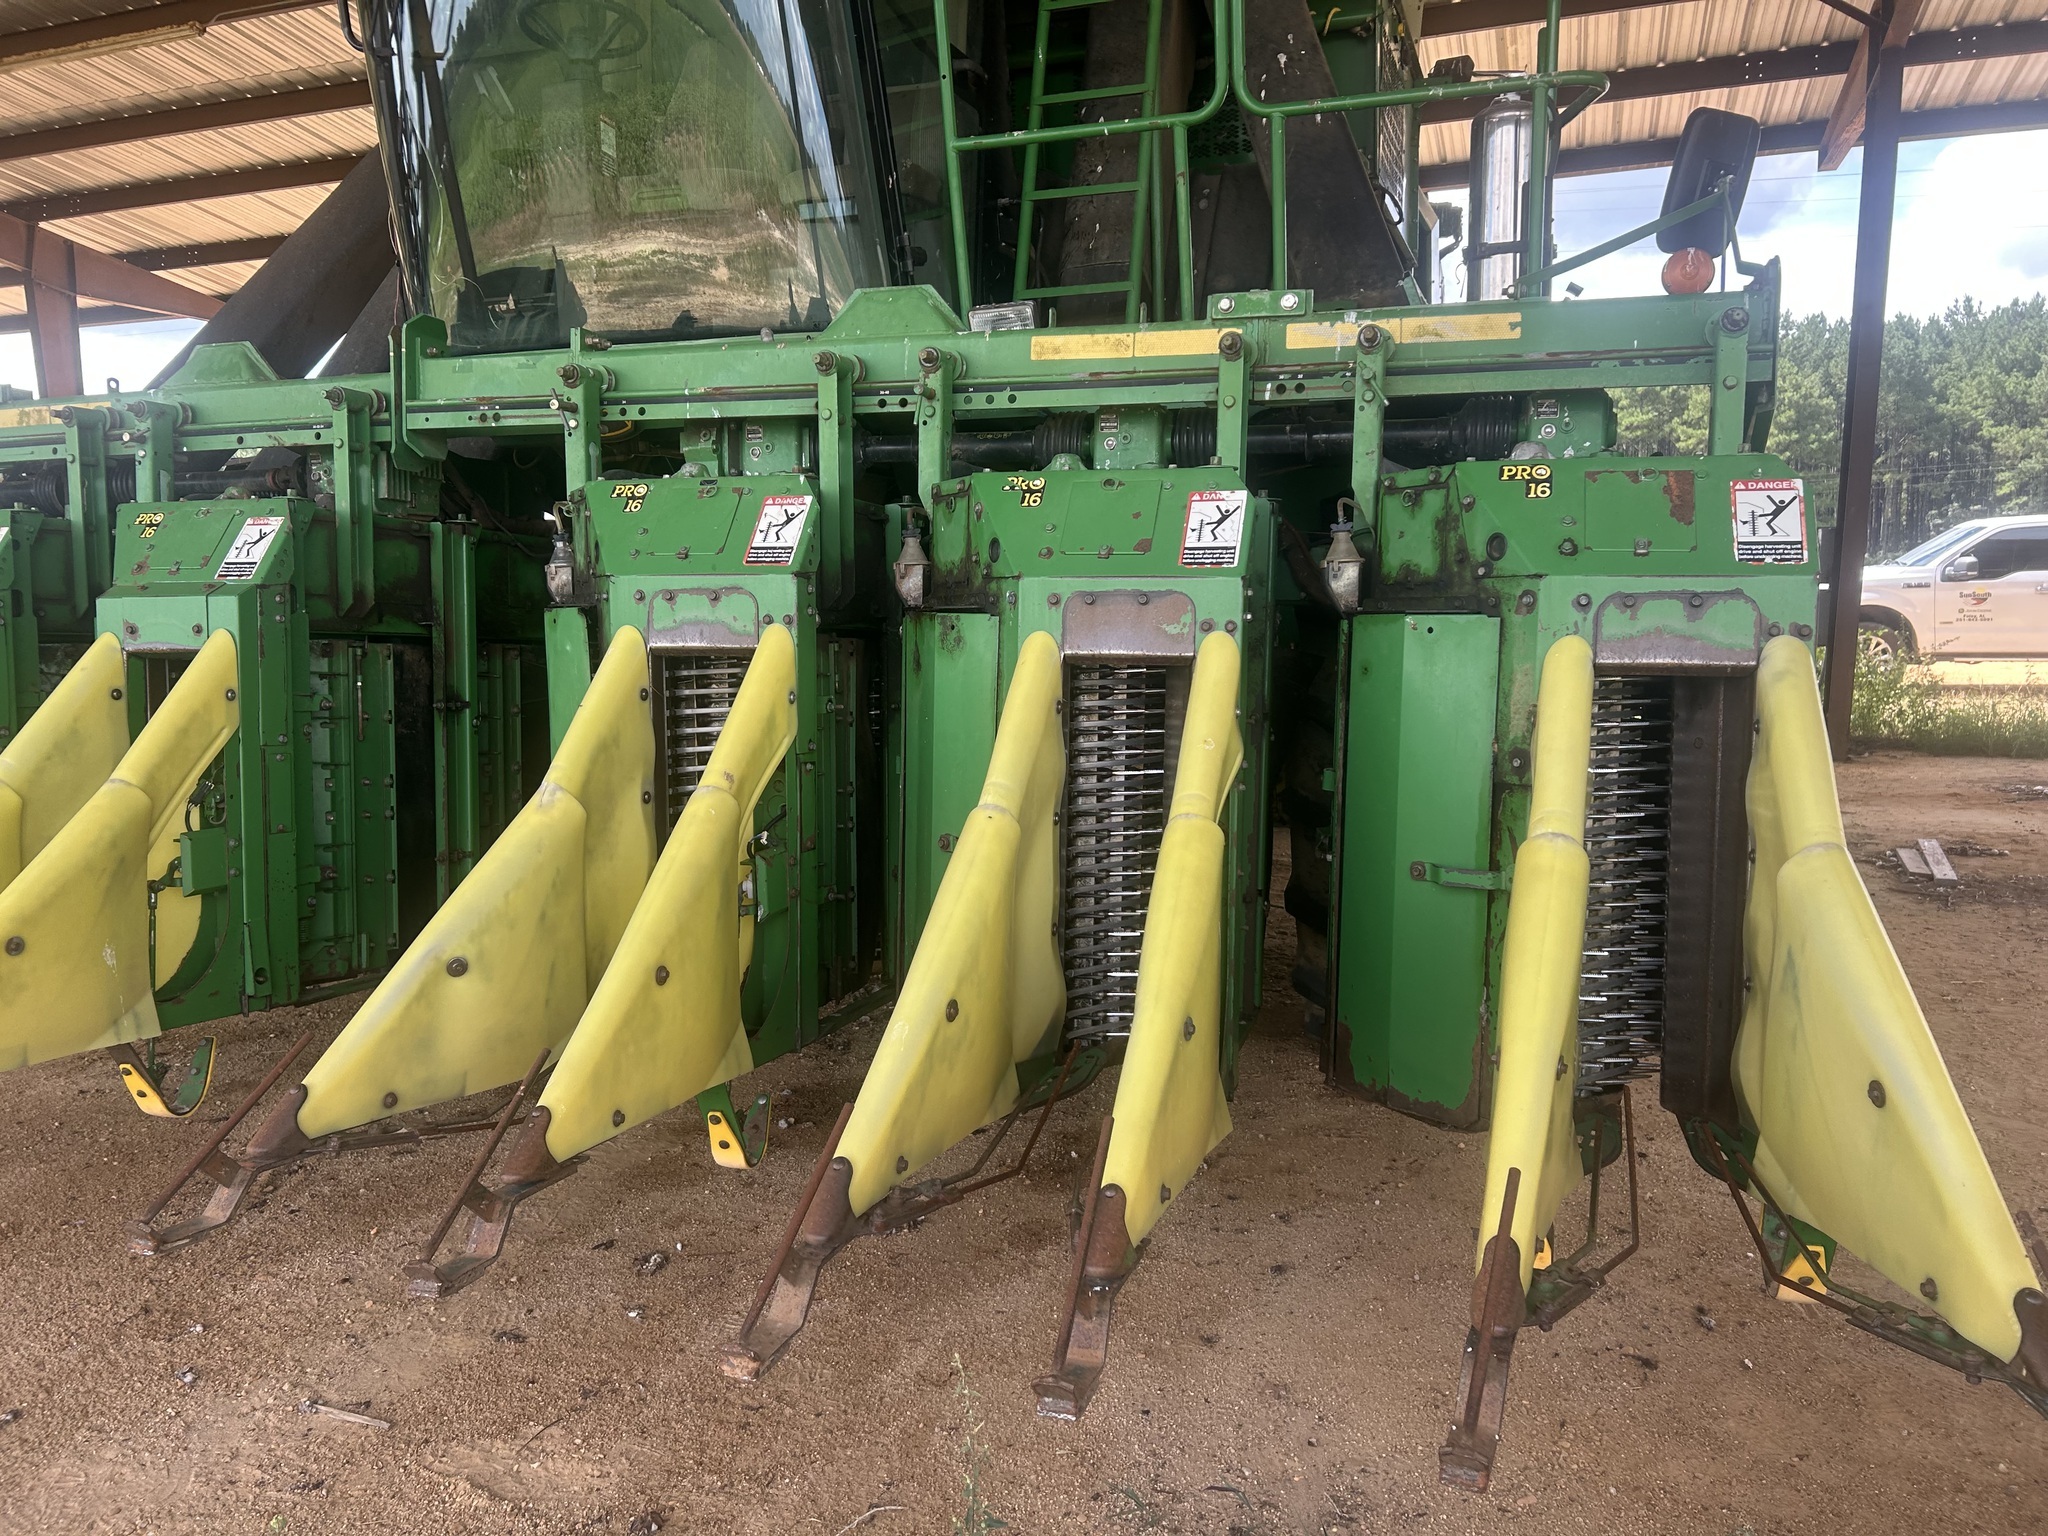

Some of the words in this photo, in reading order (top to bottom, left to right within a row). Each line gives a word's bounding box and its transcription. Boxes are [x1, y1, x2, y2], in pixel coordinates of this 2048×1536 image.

[1500, 464, 1551, 480] PRO
[611, 484, 648, 497] PRO
[1527, 482, 1551, 498] 16
[623, 499, 643, 512] 16
[1021, 492, 1042, 507] 16
[134, 512, 165, 524] PRO
[140, 526, 158, 538] 16
